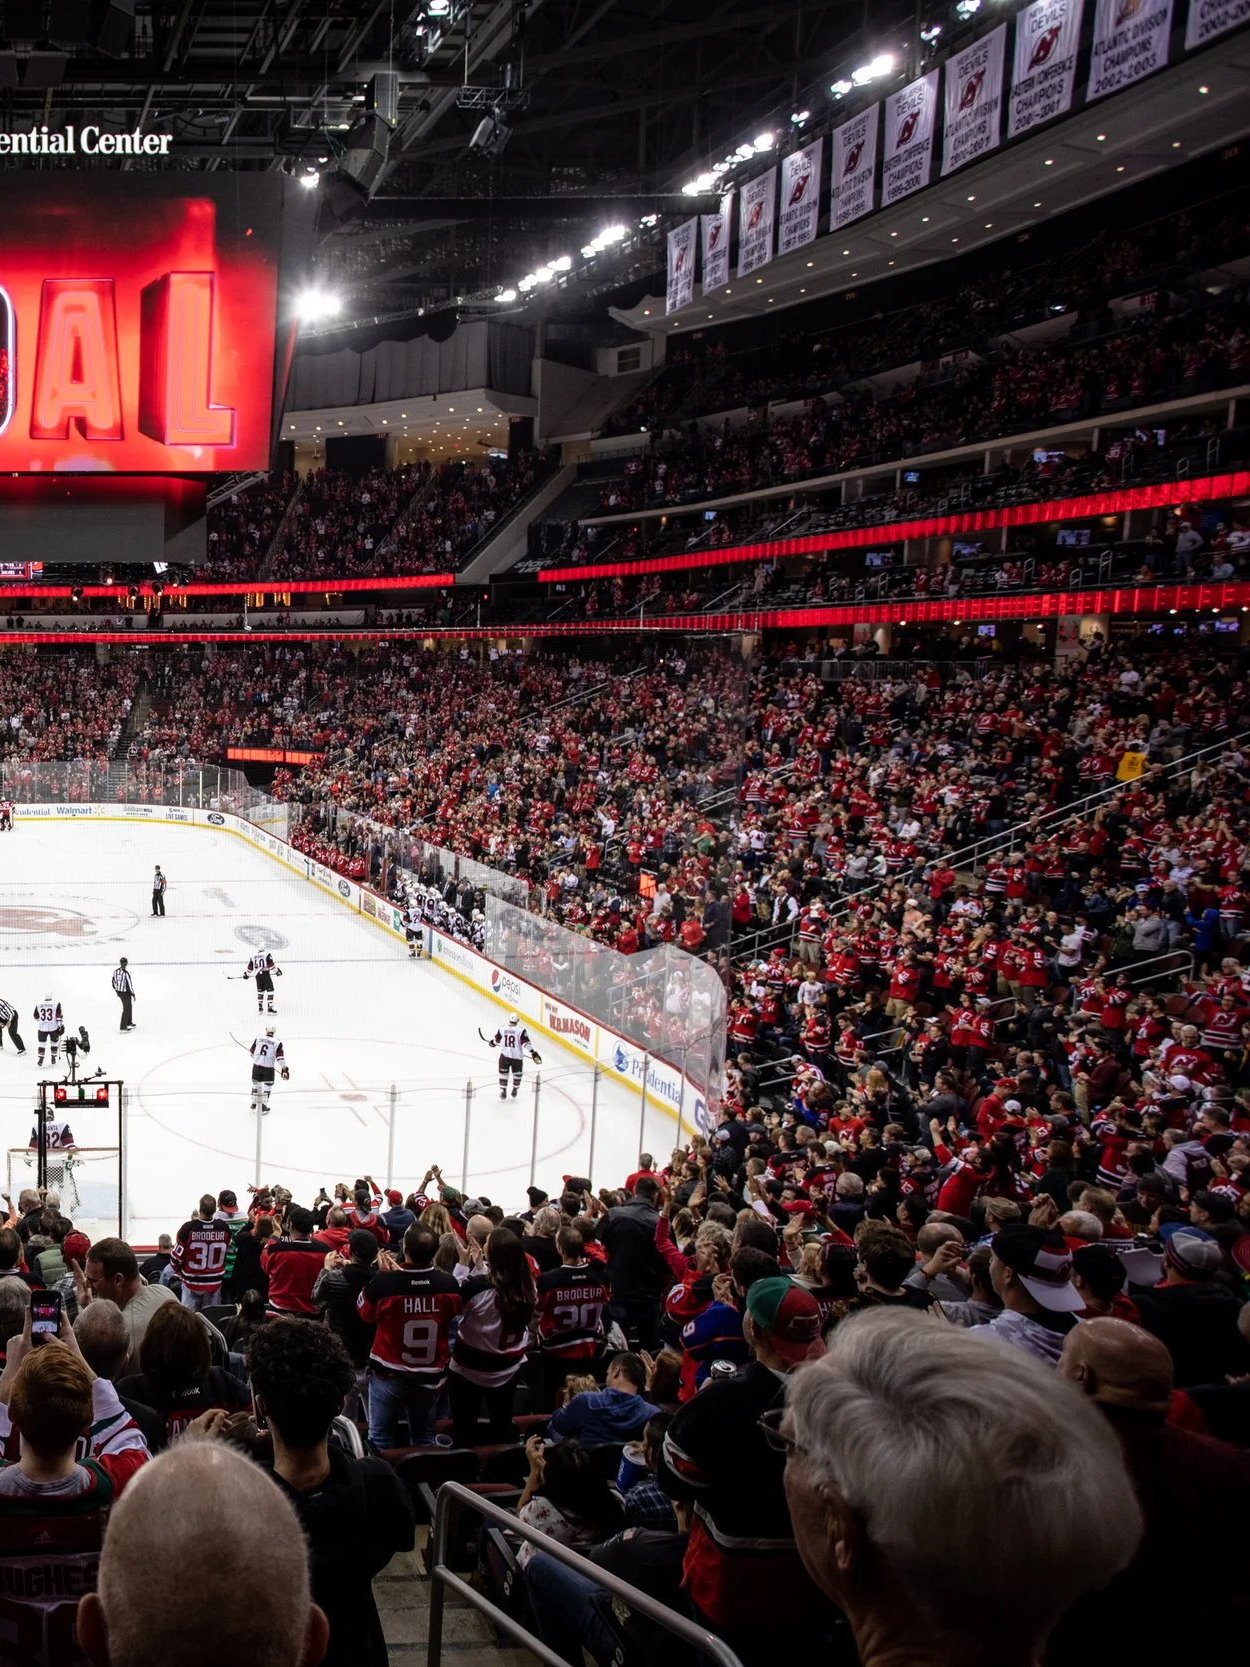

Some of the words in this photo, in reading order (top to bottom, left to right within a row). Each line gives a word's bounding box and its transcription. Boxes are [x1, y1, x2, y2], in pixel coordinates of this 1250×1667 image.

[1031, 3, 1067, 33] DEVILS
[1094, 28, 1130, 58] ATLANTIC
[1131, 7, 1168, 40] DIVISION
[959, 50, 989, 79] DEVILS
[1103, 35, 1153, 73] CHAMPIONS
[1094, 52, 1158, 94] 2002-2003
[897, 92, 923, 117] DEVILS
[1015, 78, 1065, 115] CHAMPIONS
[80, 126, 173, 156] Center
[14, 807, 51, 816] rudential
[56, 806, 93, 815] Walmart
[174, 814, 188, 822] GAMES
[209, 814, 224, 824] Ford
[501, 976, 521, 997] pepsi
[40, 1008, 53, 1022] 33
[260, 1044, 268, 1056] 6
[504, 1034, 516, 1048] 18
[631, 1058, 682, 1104] Prdentia
[191, 1231, 225, 1241] BRODEUR
[188, 1241, 228, 1271] 30
[404, 1297, 440, 1314] HALL
[556, 1287, 603, 1302] BRODEUR
[553, 1302, 604, 1331] 30
[401, 1318, 439, 1365] 9
